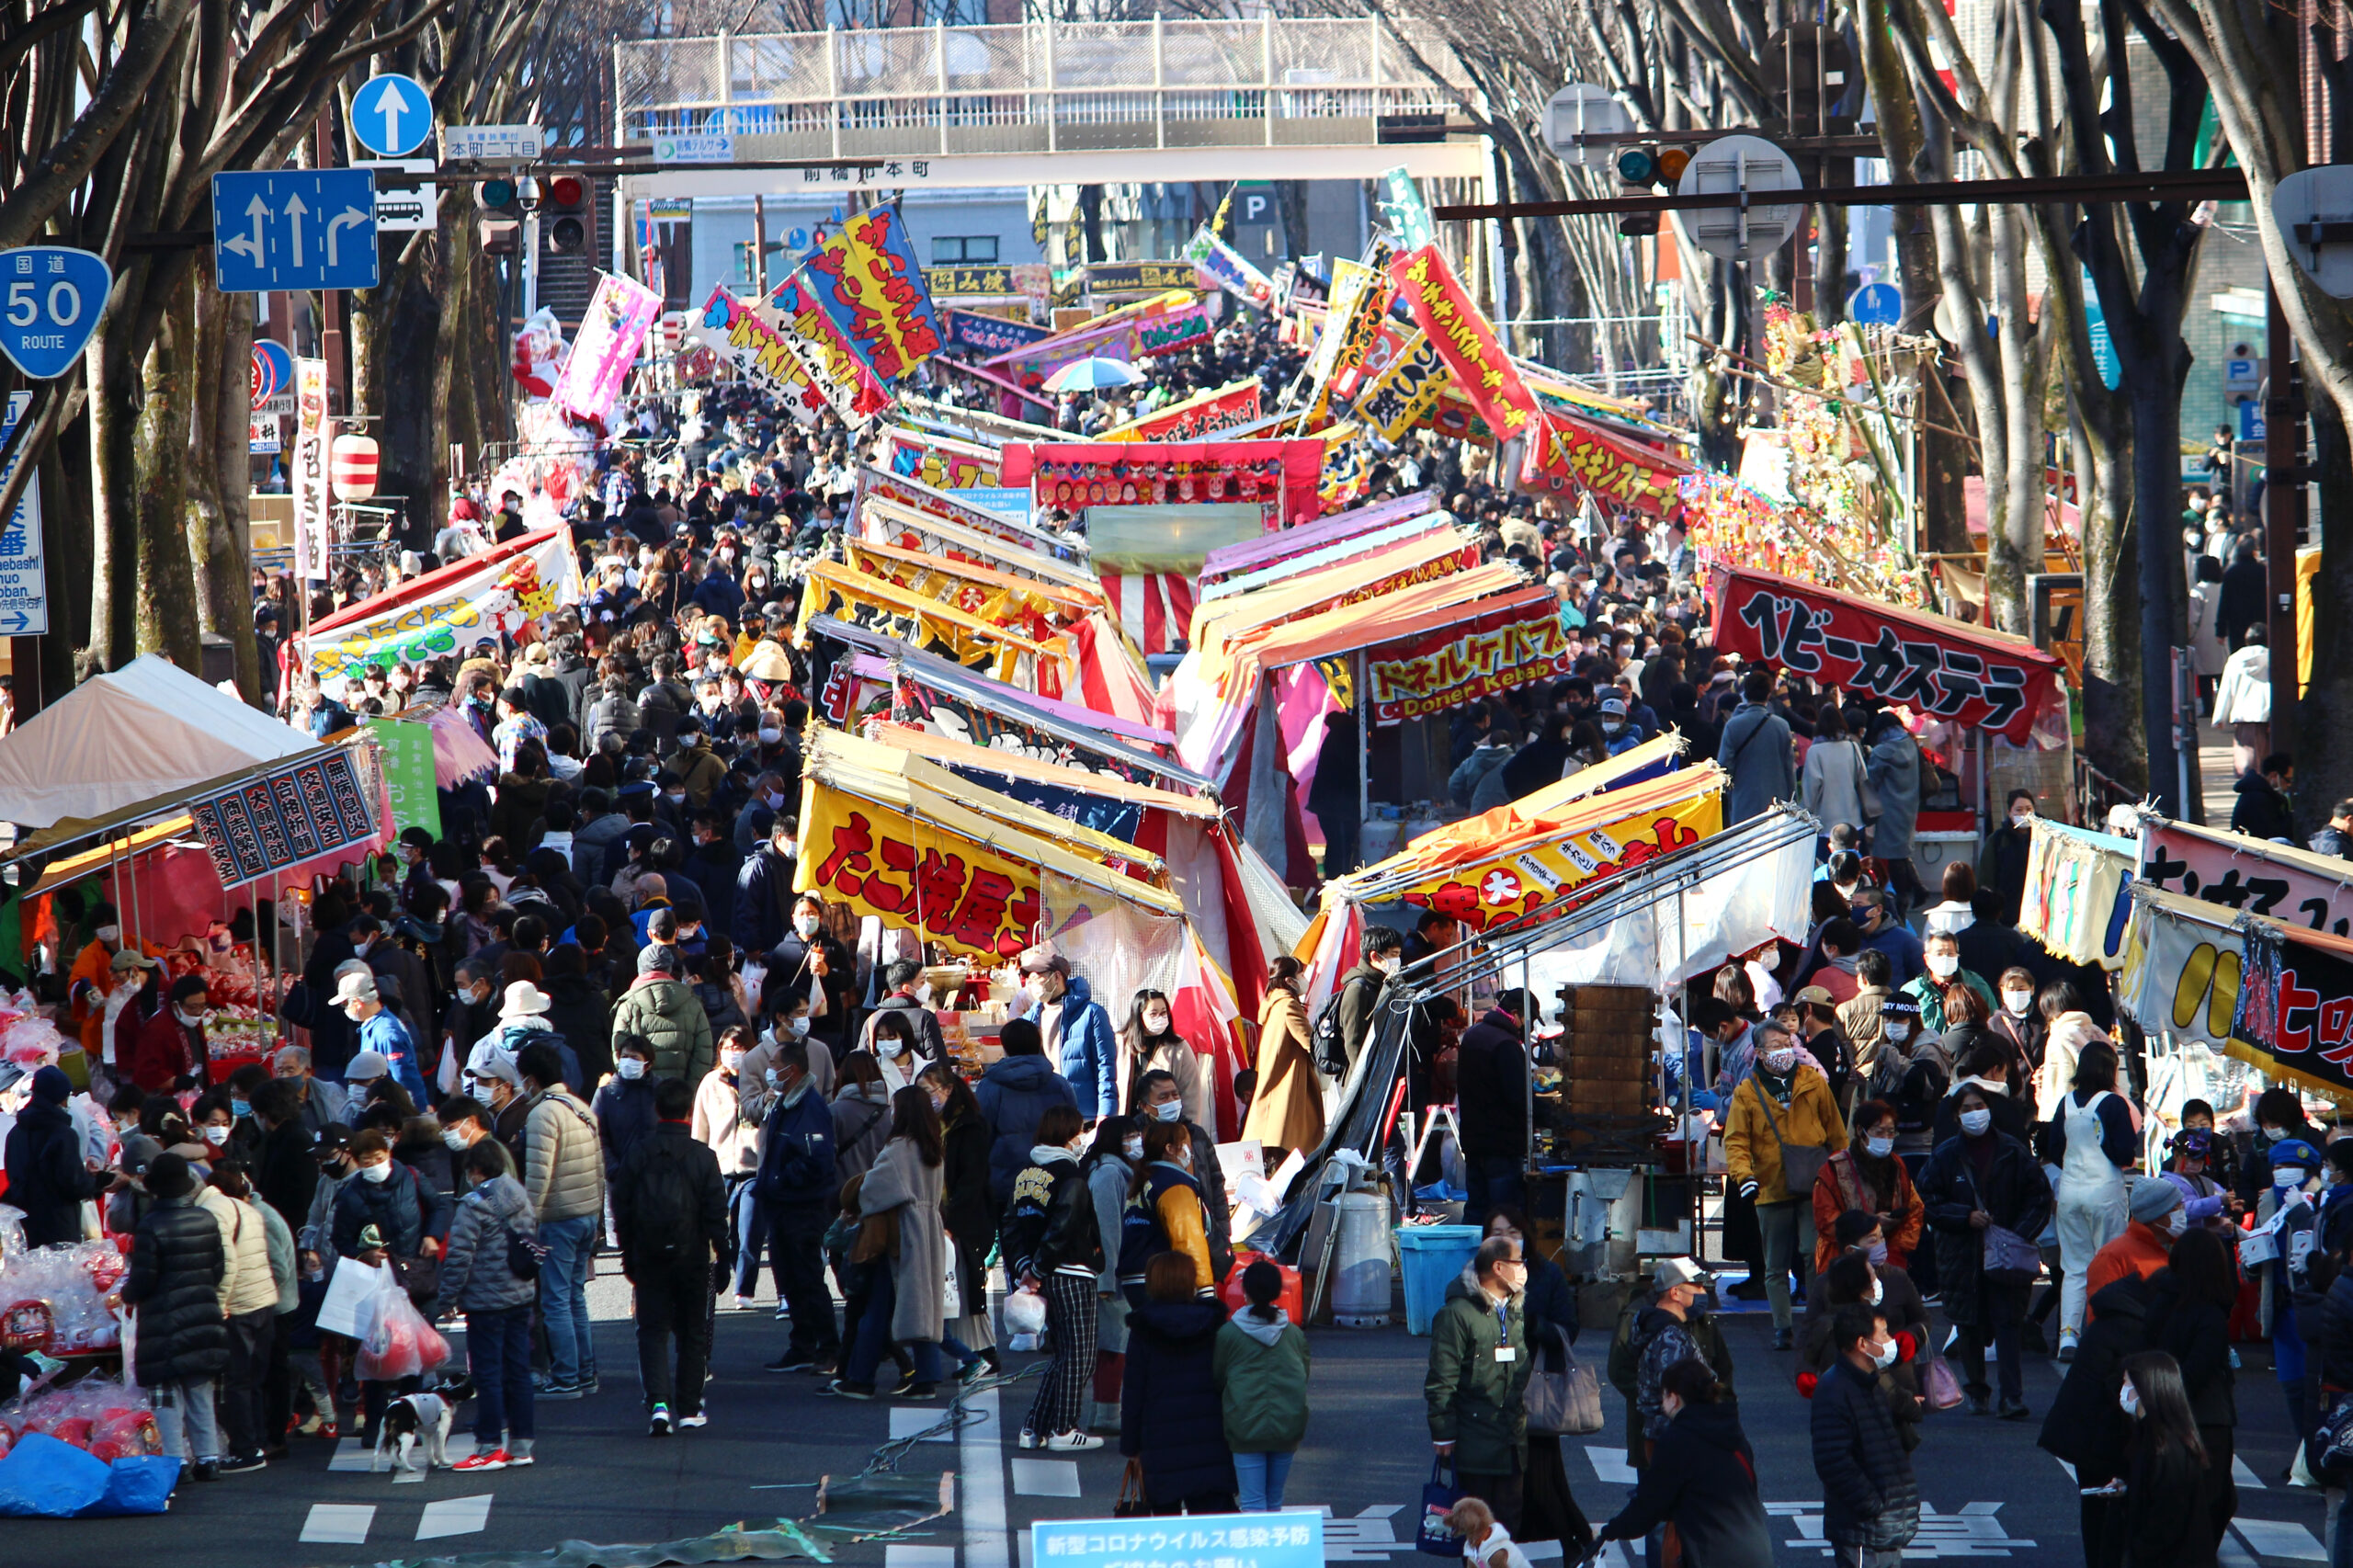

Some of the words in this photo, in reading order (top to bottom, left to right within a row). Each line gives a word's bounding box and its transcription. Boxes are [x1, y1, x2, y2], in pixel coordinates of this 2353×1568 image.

[450, 142, 535, 157] 本町二丁目
[1247, 196, 1267, 220] P
[16, 255, 66, 274] 国道
[6, 280, 81, 327] 50
[21, 335, 66, 349] ROUTE
[1375, 616, 1568, 701] ドネルケバブ
[1739, 591, 2027, 729] ベビーカステラ
[1404, 683, 1475, 717] Doner
[1484, 662, 1550, 692] Kebab
[275, 780, 314, 853] 合格祈願
[301, 770, 341, 846] 交通安全
[326, 761, 367, 835] 無病息災
[197, 809, 236, 882] 家内安全
[222, 799, 263, 872] 商売繁盛
[249, 790, 289, 861] 大願成就
[1518, 854, 1557, 887] サイコロステーキ
[1561, 842, 1594, 870] 牛カルビ
[1483, 870, 1521, 904] 大
[1046, 1525, 1312, 1556] 新型コロナウイルス感染予防
